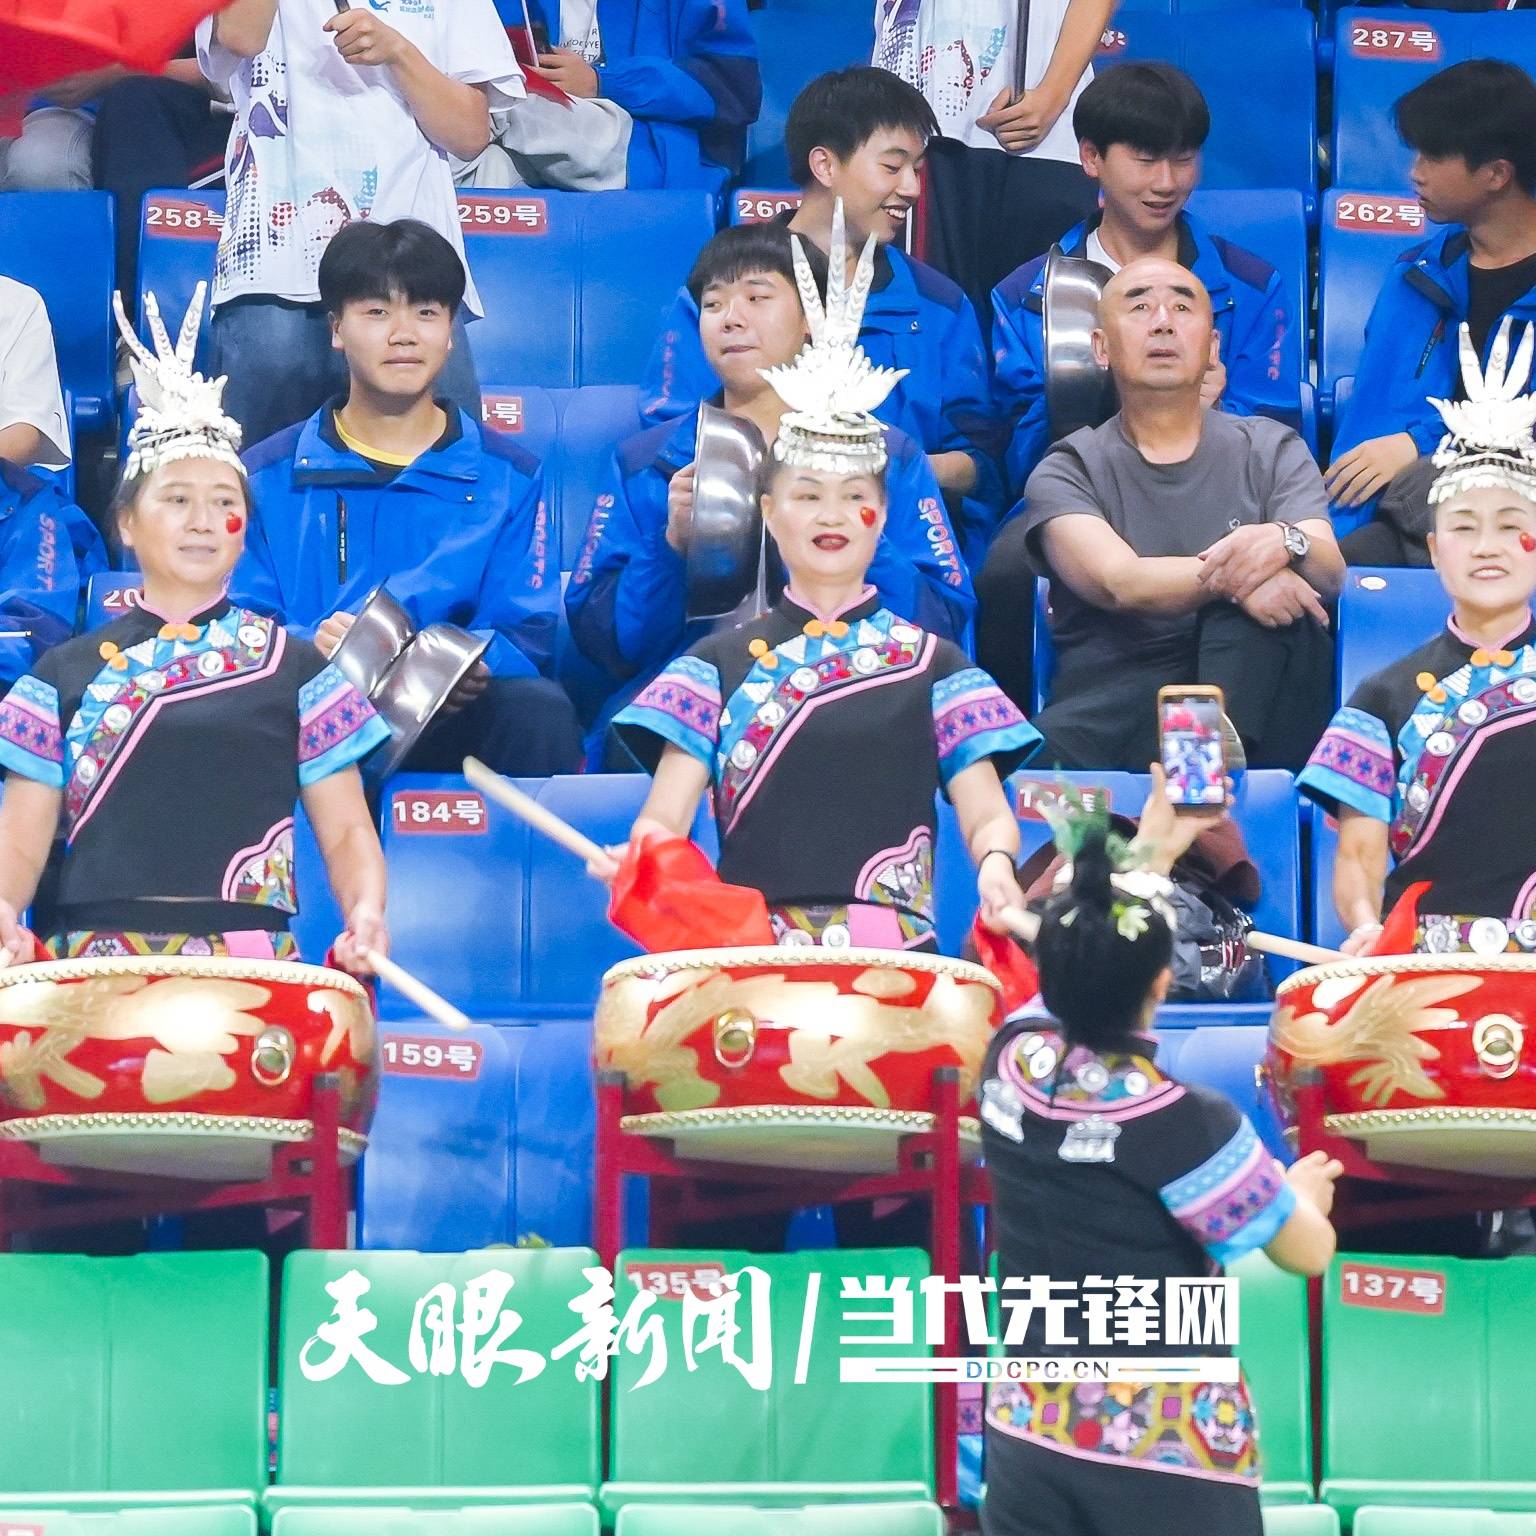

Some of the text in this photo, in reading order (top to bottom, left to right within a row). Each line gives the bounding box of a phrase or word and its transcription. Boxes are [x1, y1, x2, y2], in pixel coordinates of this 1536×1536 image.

[1352, 28, 1437, 53] 287号
[457, 203, 541, 228] 259号
[1338, 200, 1425, 228] 262号
[918, 496, 962, 587] SPORTS
[393, 798, 485, 826] 184号
[383, 1042, 477, 1073] 159号
[1344, 1271, 1443, 1305] 137号
